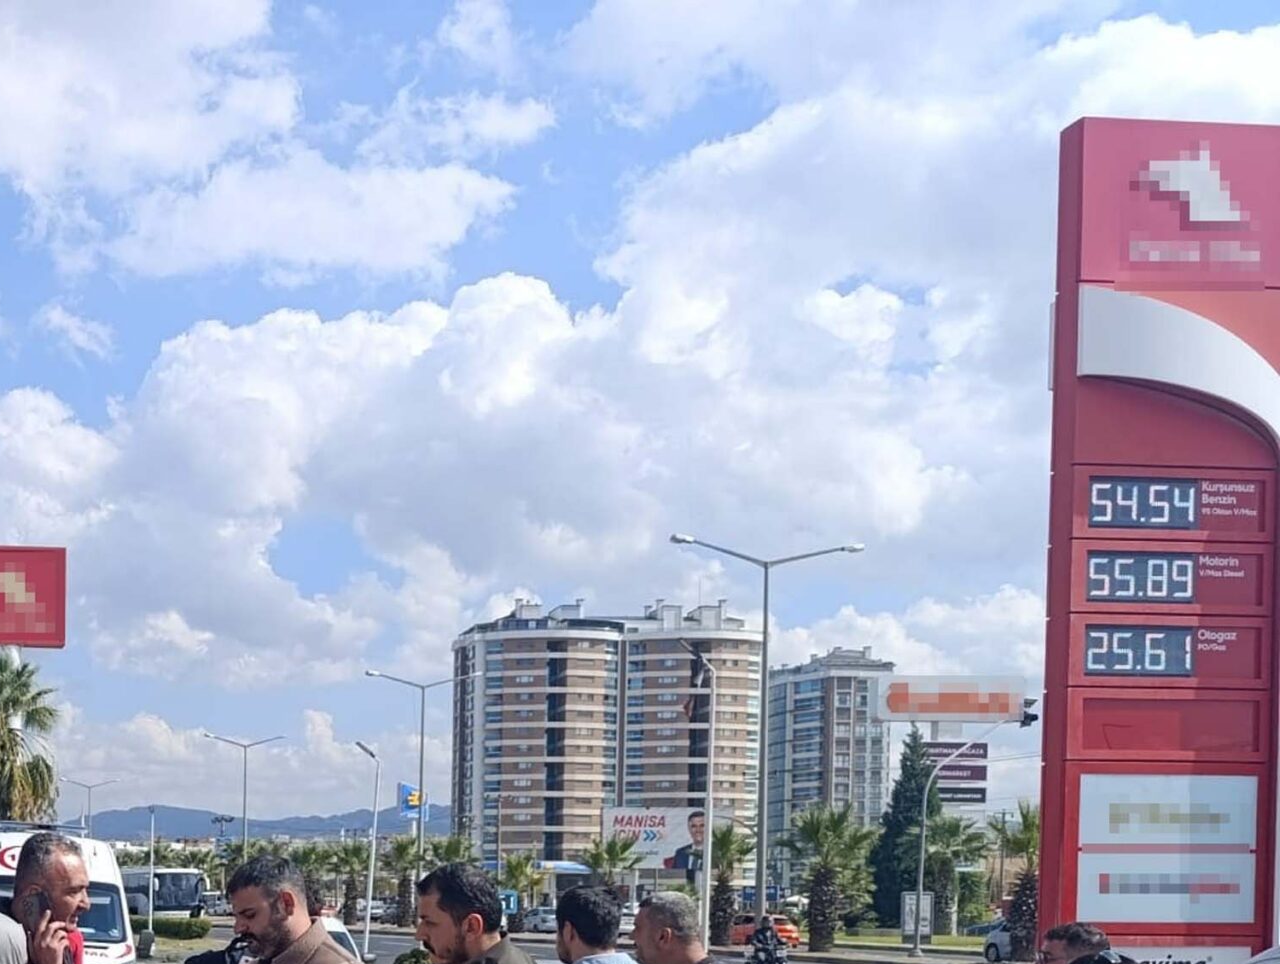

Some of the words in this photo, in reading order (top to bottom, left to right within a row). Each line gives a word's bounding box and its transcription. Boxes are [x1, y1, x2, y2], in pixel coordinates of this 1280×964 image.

[1201, 481, 1255, 493] Kurşunsuz
[1091, 483, 1196, 522] 54.54
[1201, 493, 1237, 505] Benzin
[1199, 556, 1239, 567] Motorin
[1089, 558, 1194, 598] 55.89
[1198, 629, 1238, 642] Otogaz
[1087, 632, 1192, 671] 25.61
